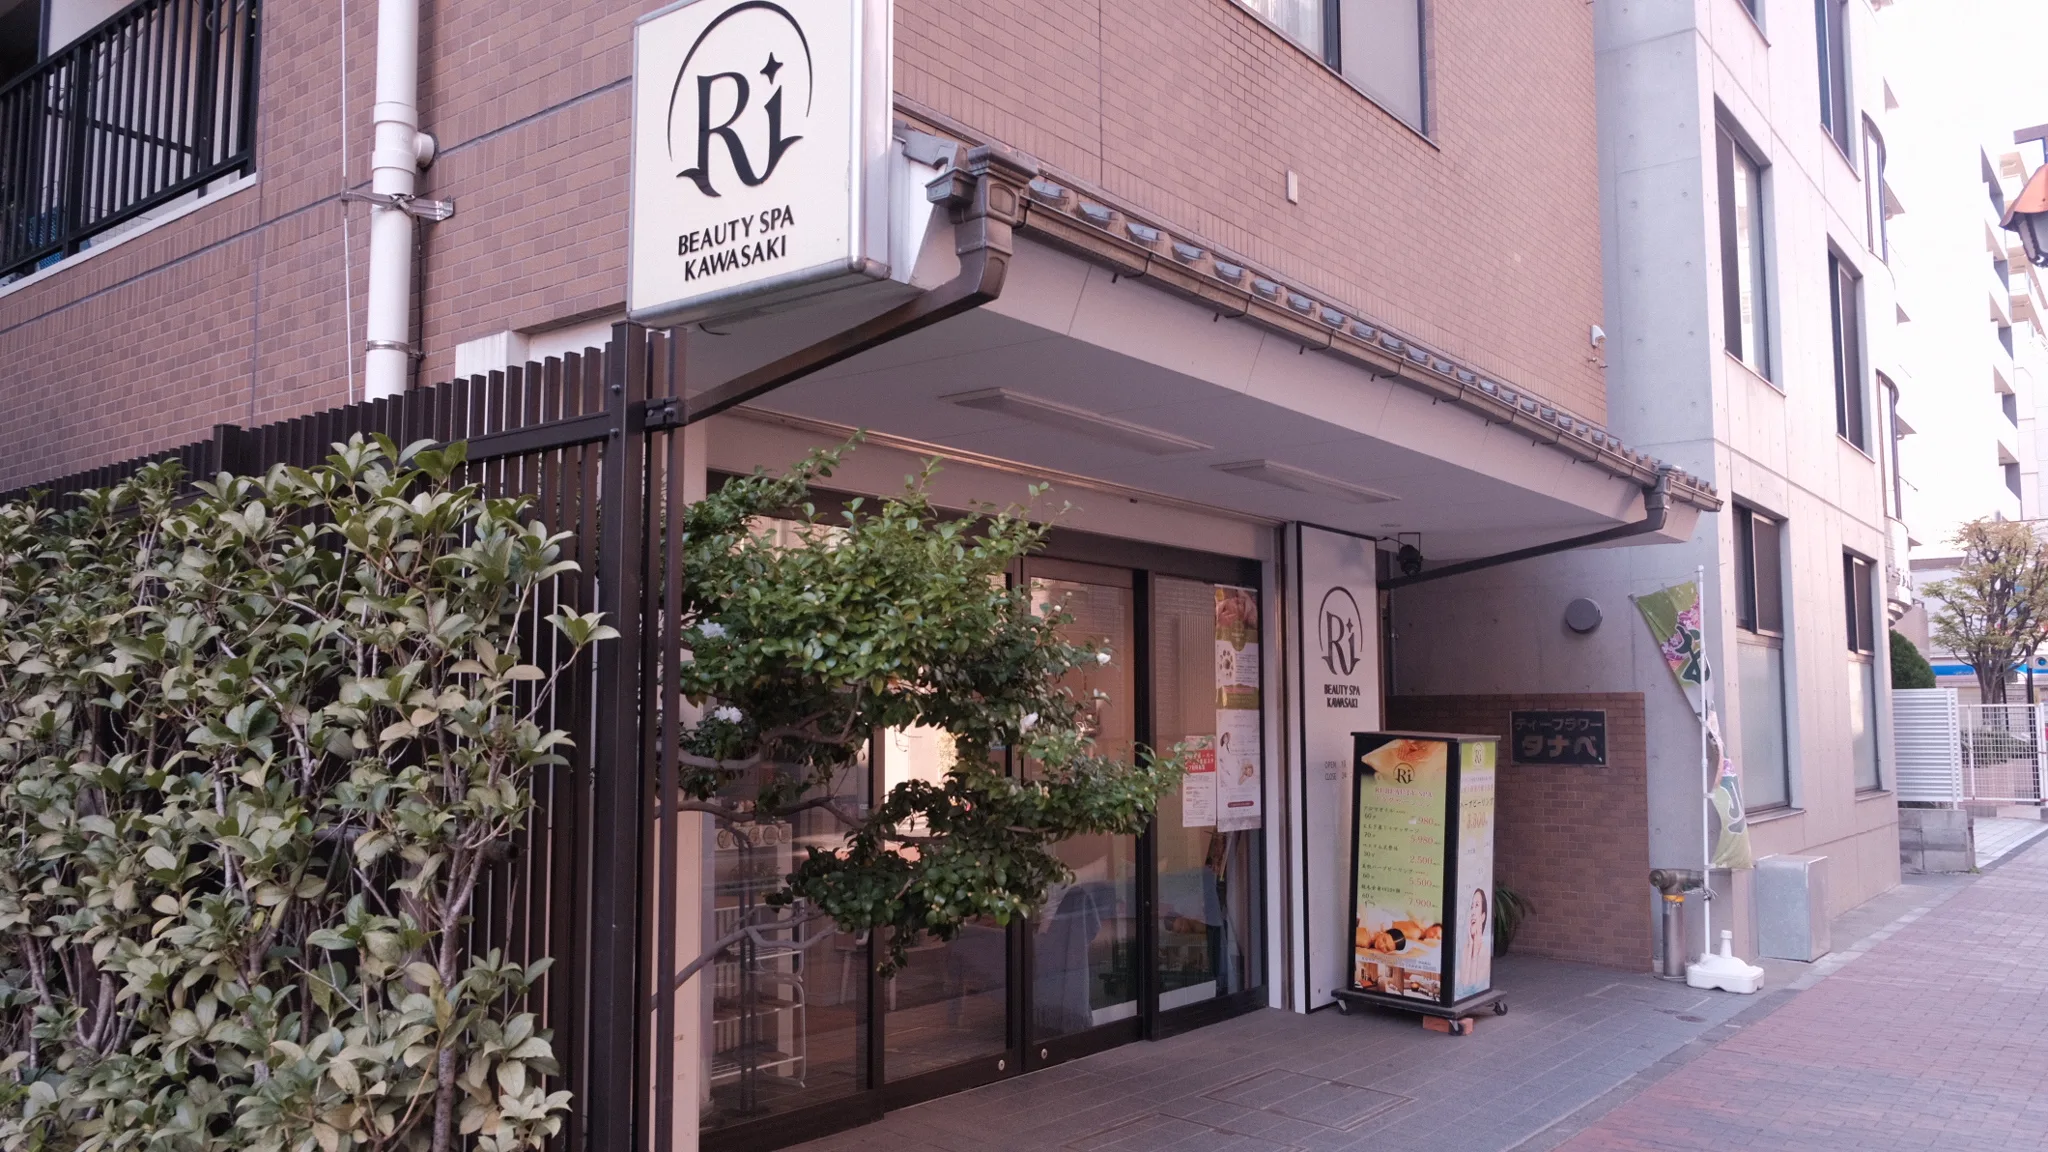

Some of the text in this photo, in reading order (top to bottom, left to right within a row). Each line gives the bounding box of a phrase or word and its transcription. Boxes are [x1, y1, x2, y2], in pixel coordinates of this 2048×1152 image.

[676, 52, 803, 197] Ri
[677, 204, 795, 256] BEAUTY SPA
[684, 235, 787, 281] KAWASAKI
[1321, 611, 1361, 676] Ri
[1324, 684, 1360, 696] BEAUTY SPA
[1327, 698, 1358, 708] KAWASAKI
[1515, 718, 1602, 731] ティーフラワー
[1522, 735, 1598, 757] タナベ
[1324, 761, 1336, 769] OPEN
[1396, 767, 1413, 784] Ri
